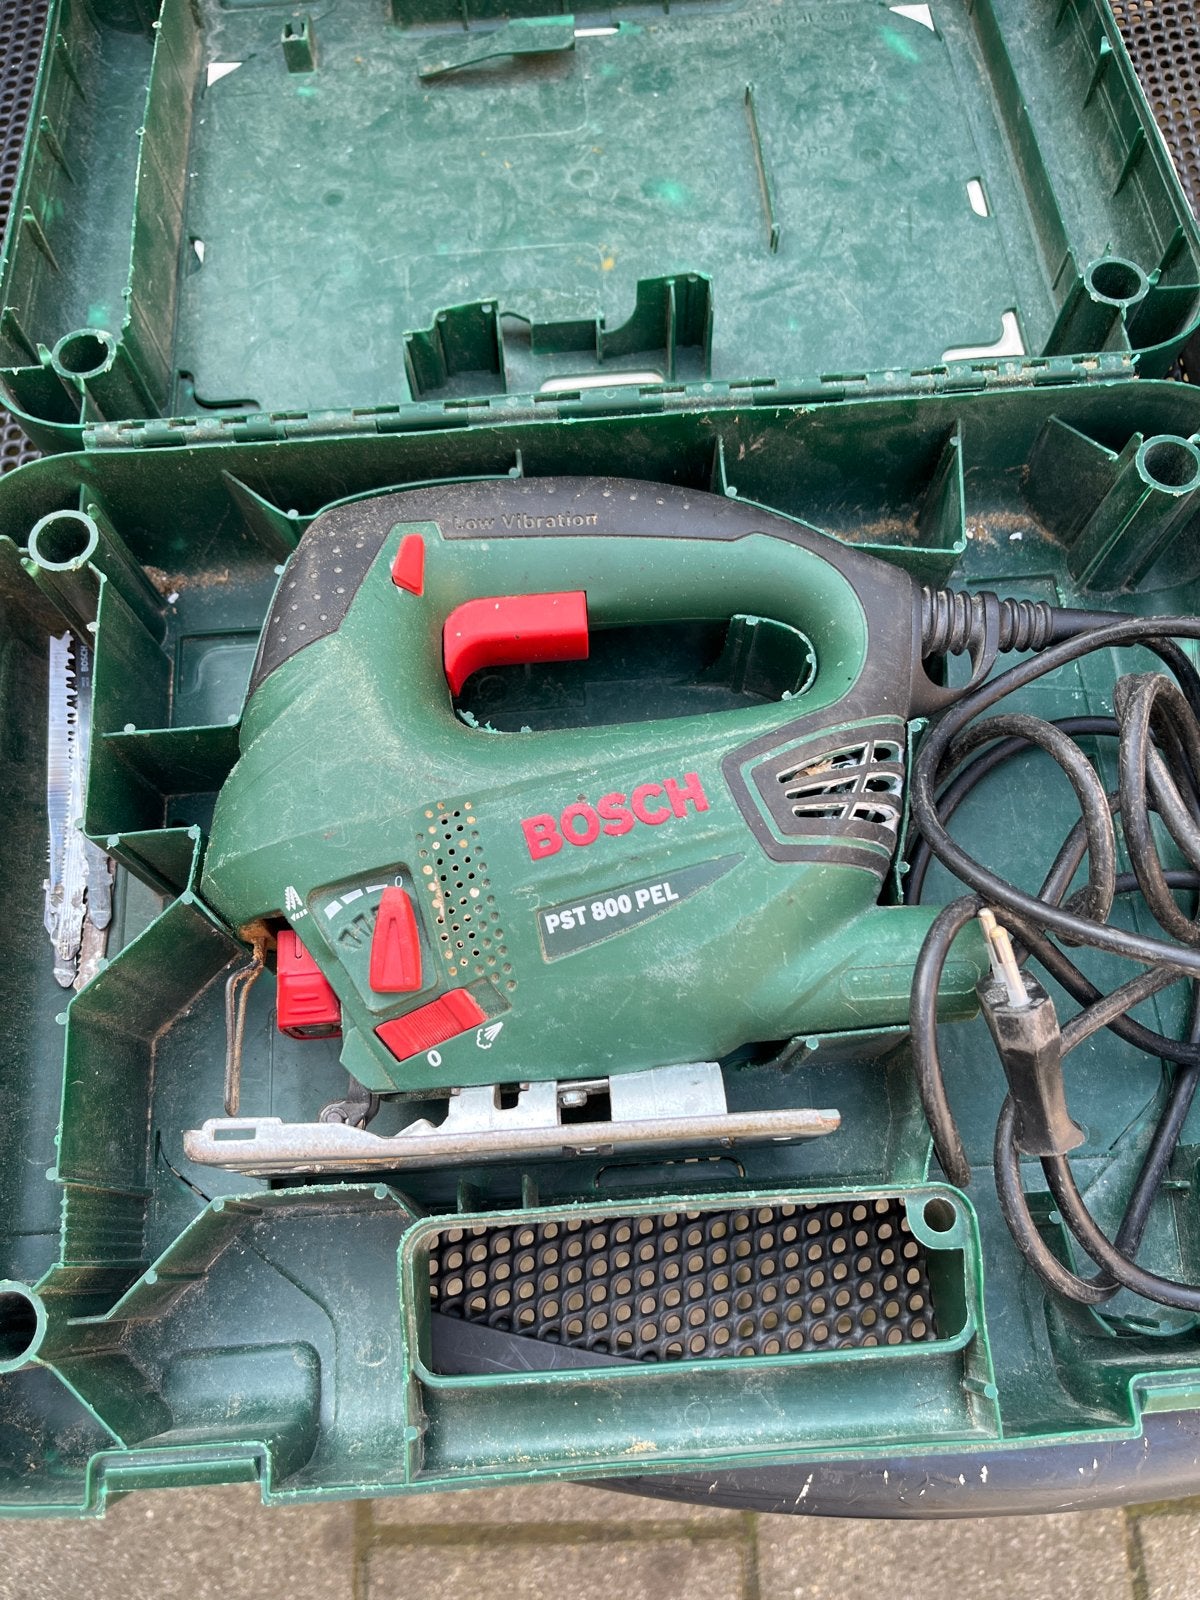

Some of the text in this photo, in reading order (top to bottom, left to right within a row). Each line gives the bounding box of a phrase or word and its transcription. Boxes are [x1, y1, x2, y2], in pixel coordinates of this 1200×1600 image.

[453, 511, 599, 530] Low Vibration
[80, 645, 89, 672] BOSCH
[520, 772, 710, 862] BOSCH
[544, 882, 680, 934] PST 800 PEL
[427, 1049, 442, 1067] 0
